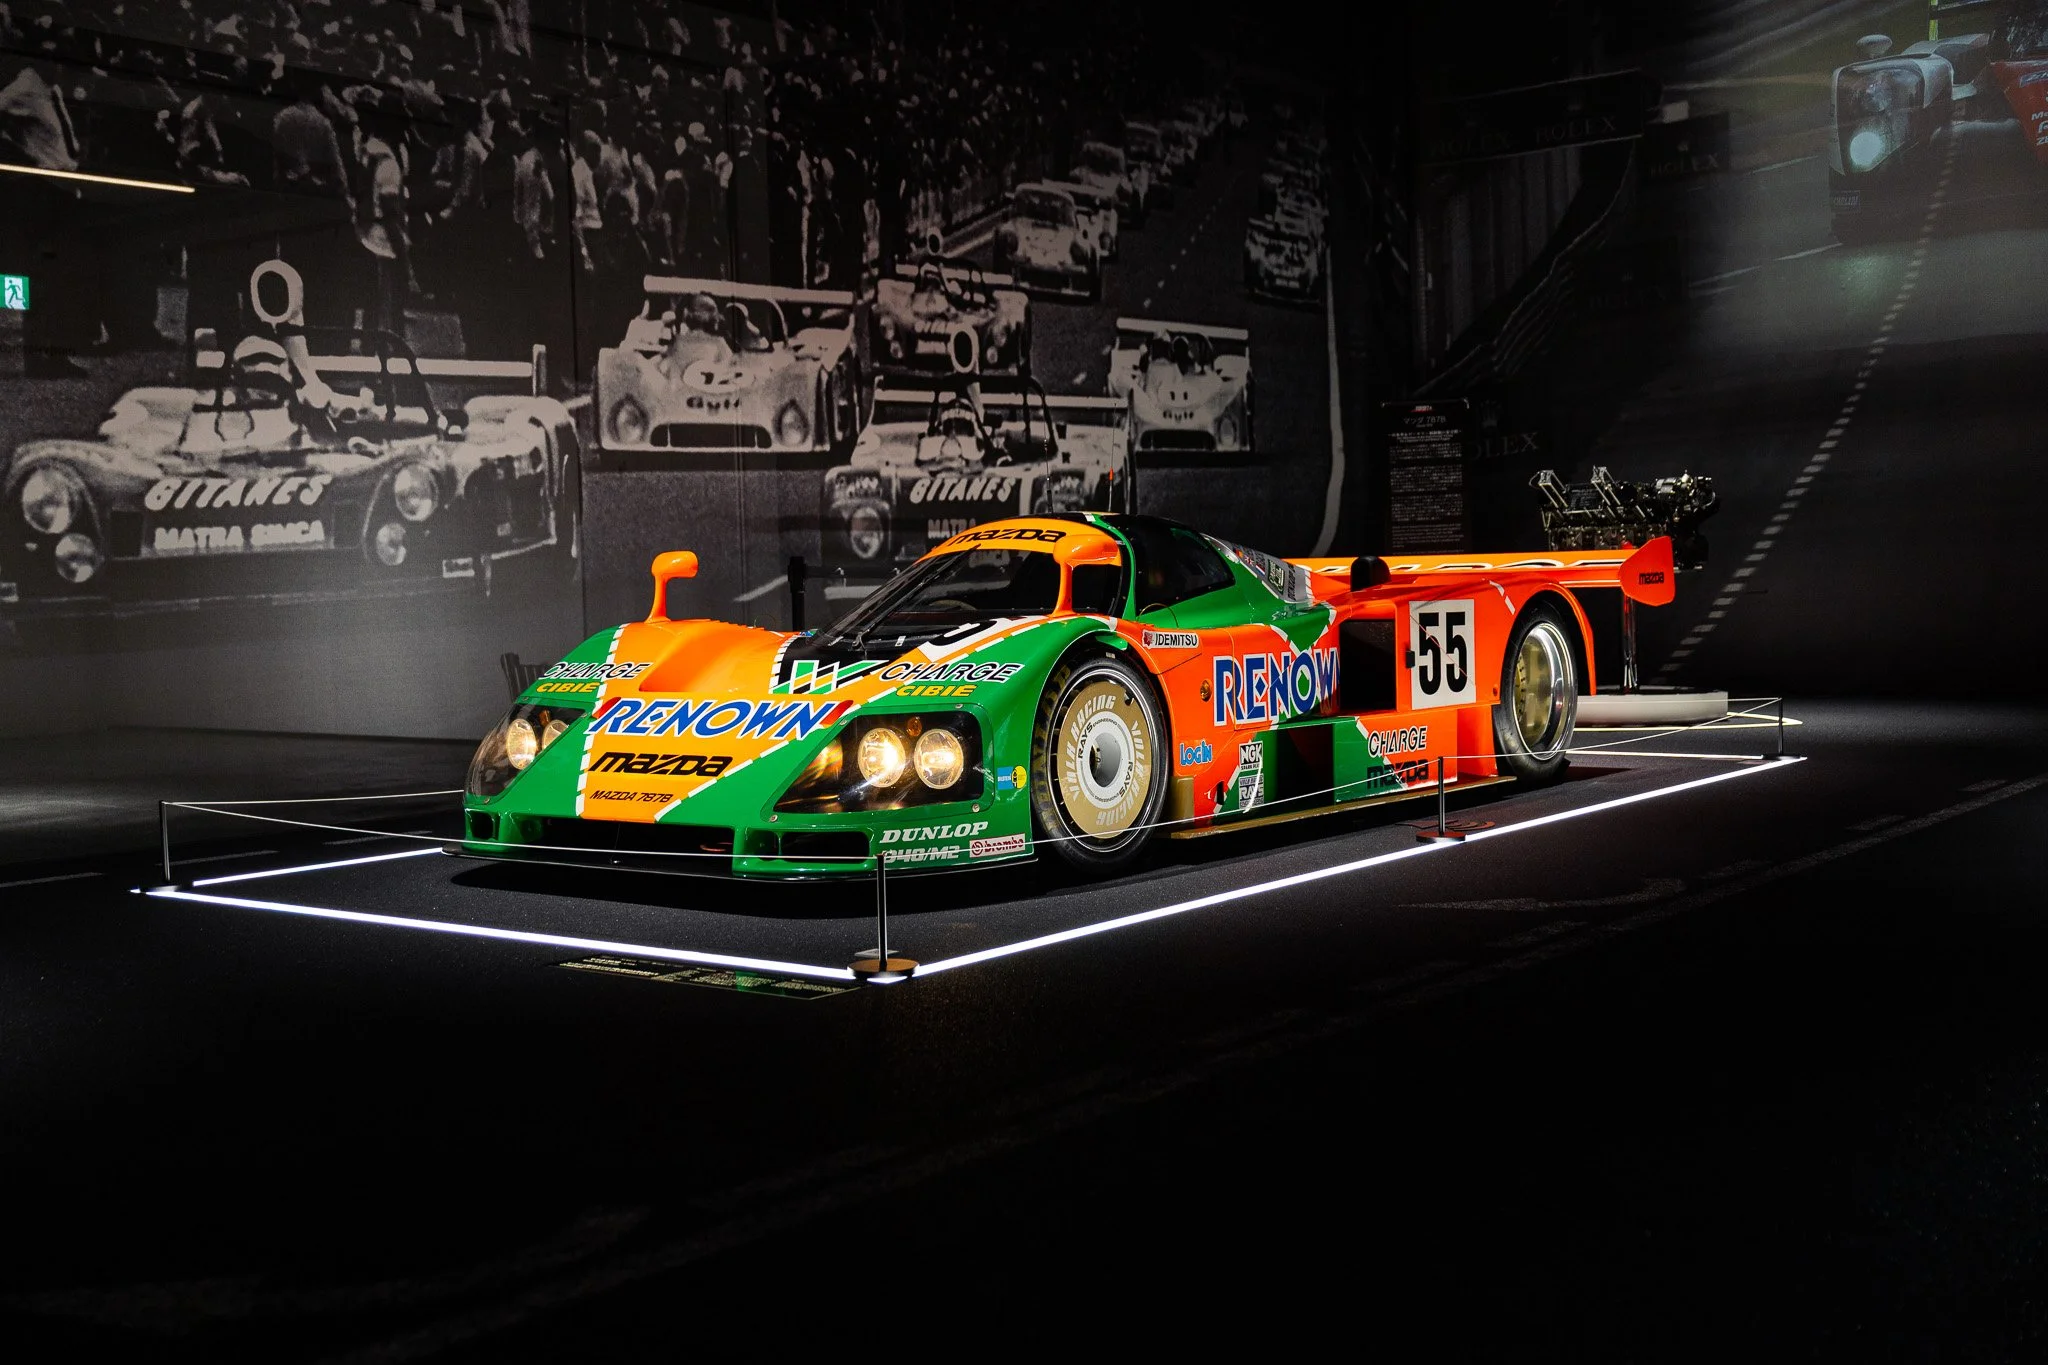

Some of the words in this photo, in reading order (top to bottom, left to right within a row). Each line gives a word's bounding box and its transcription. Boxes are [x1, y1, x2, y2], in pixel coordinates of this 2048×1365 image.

[1535, 115, 1617, 144] ROLEX
[145, 474, 332, 511] GITANES
[910, 476, 1016, 504] GITANES
[1155, 633, 1198, 647] IDEMITSU
[1418, 611, 1468, 695] 55
[538, 661, 653, 680] CHARGE
[880, 662, 1025, 683] CHARGE
[1213, 647, 1340, 727] RENOW
[583, 699, 837, 740] RENOWN
[1241, 743, 1262, 764] NGK
[1368, 725, 1428, 758] CHARGE
[588, 751, 734, 777] mazda
[589, 790, 638, 802] MAZDA
[636, 792, 674, 804] 787B
[879, 821, 989, 843] DUNLOP
